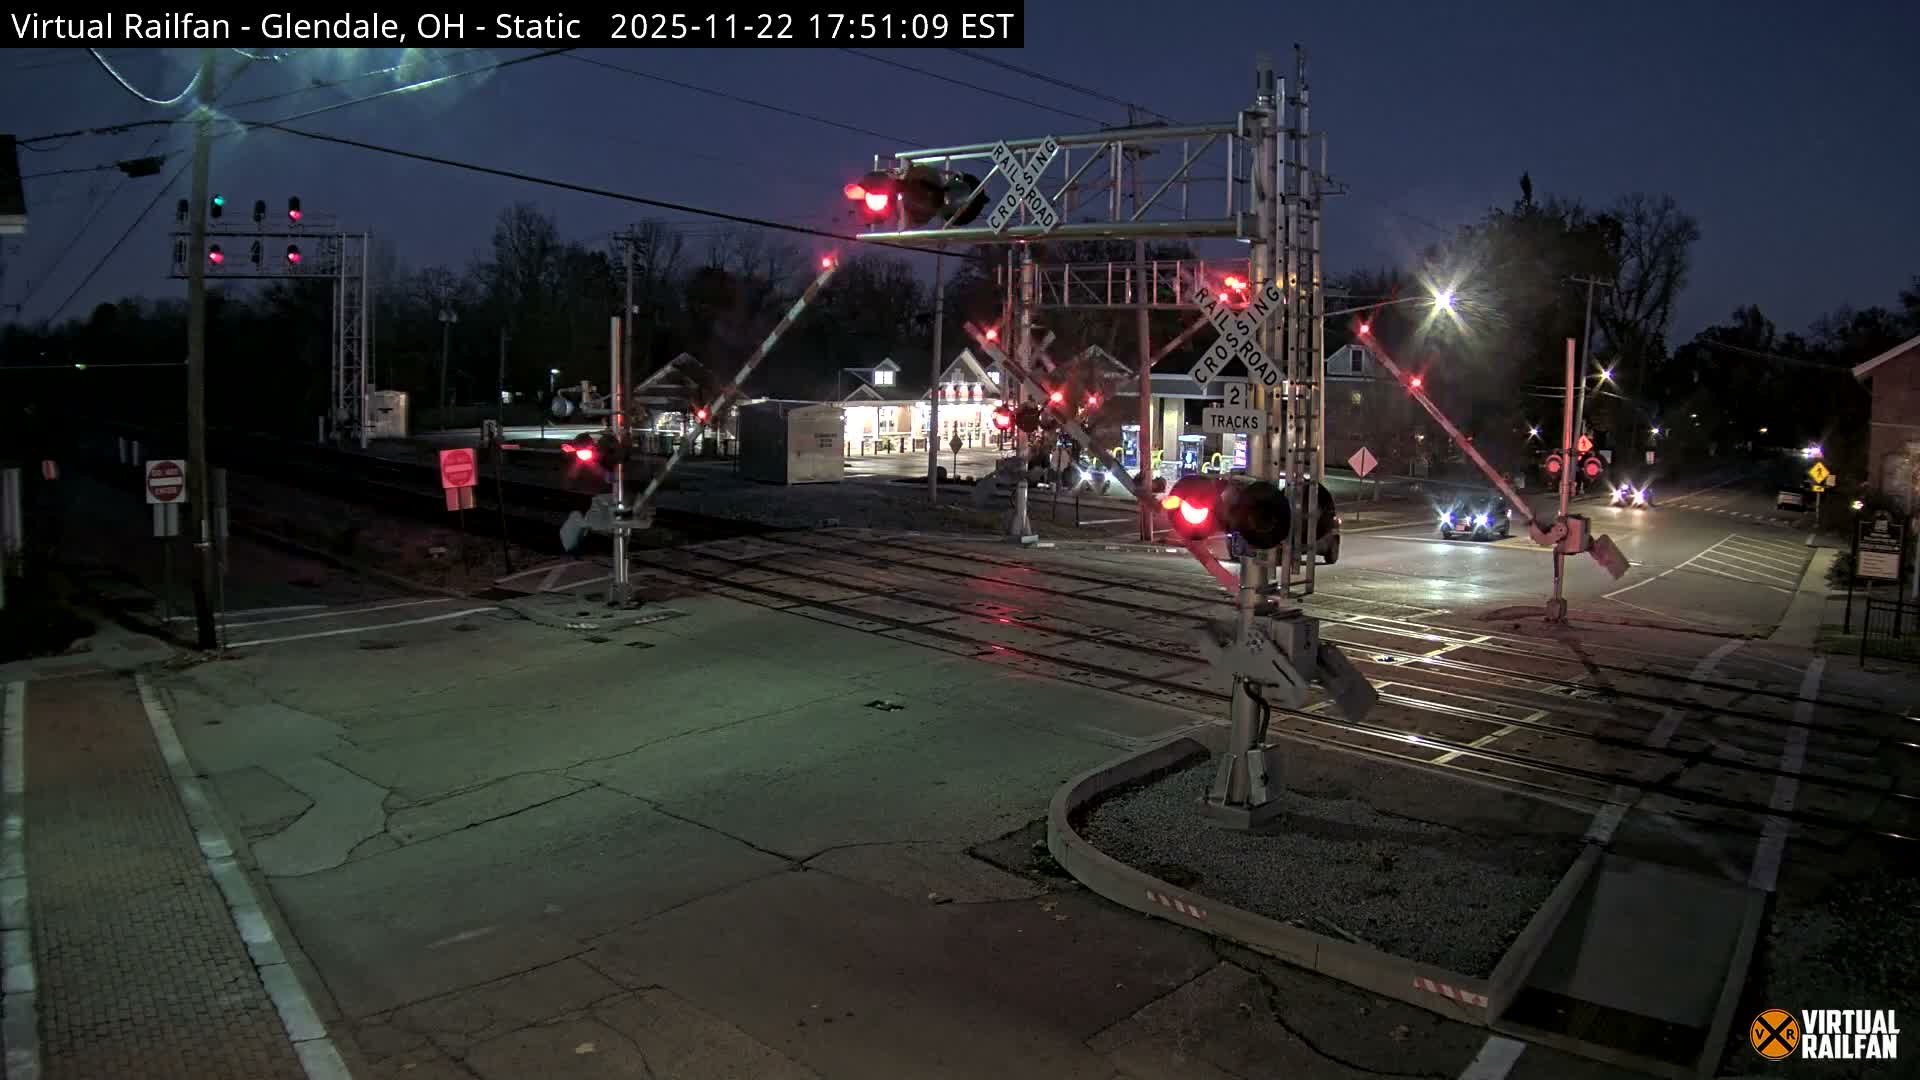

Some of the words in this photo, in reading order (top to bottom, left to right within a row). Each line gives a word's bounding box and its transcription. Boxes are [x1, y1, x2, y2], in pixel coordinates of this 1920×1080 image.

[990, 140, 1056, 229] CROSSING
[1194, 286, 1280, 384] CROSSING
[1210, 414, 1259, 429] TRACKS
[1229, 387, 1240, 405] 2
